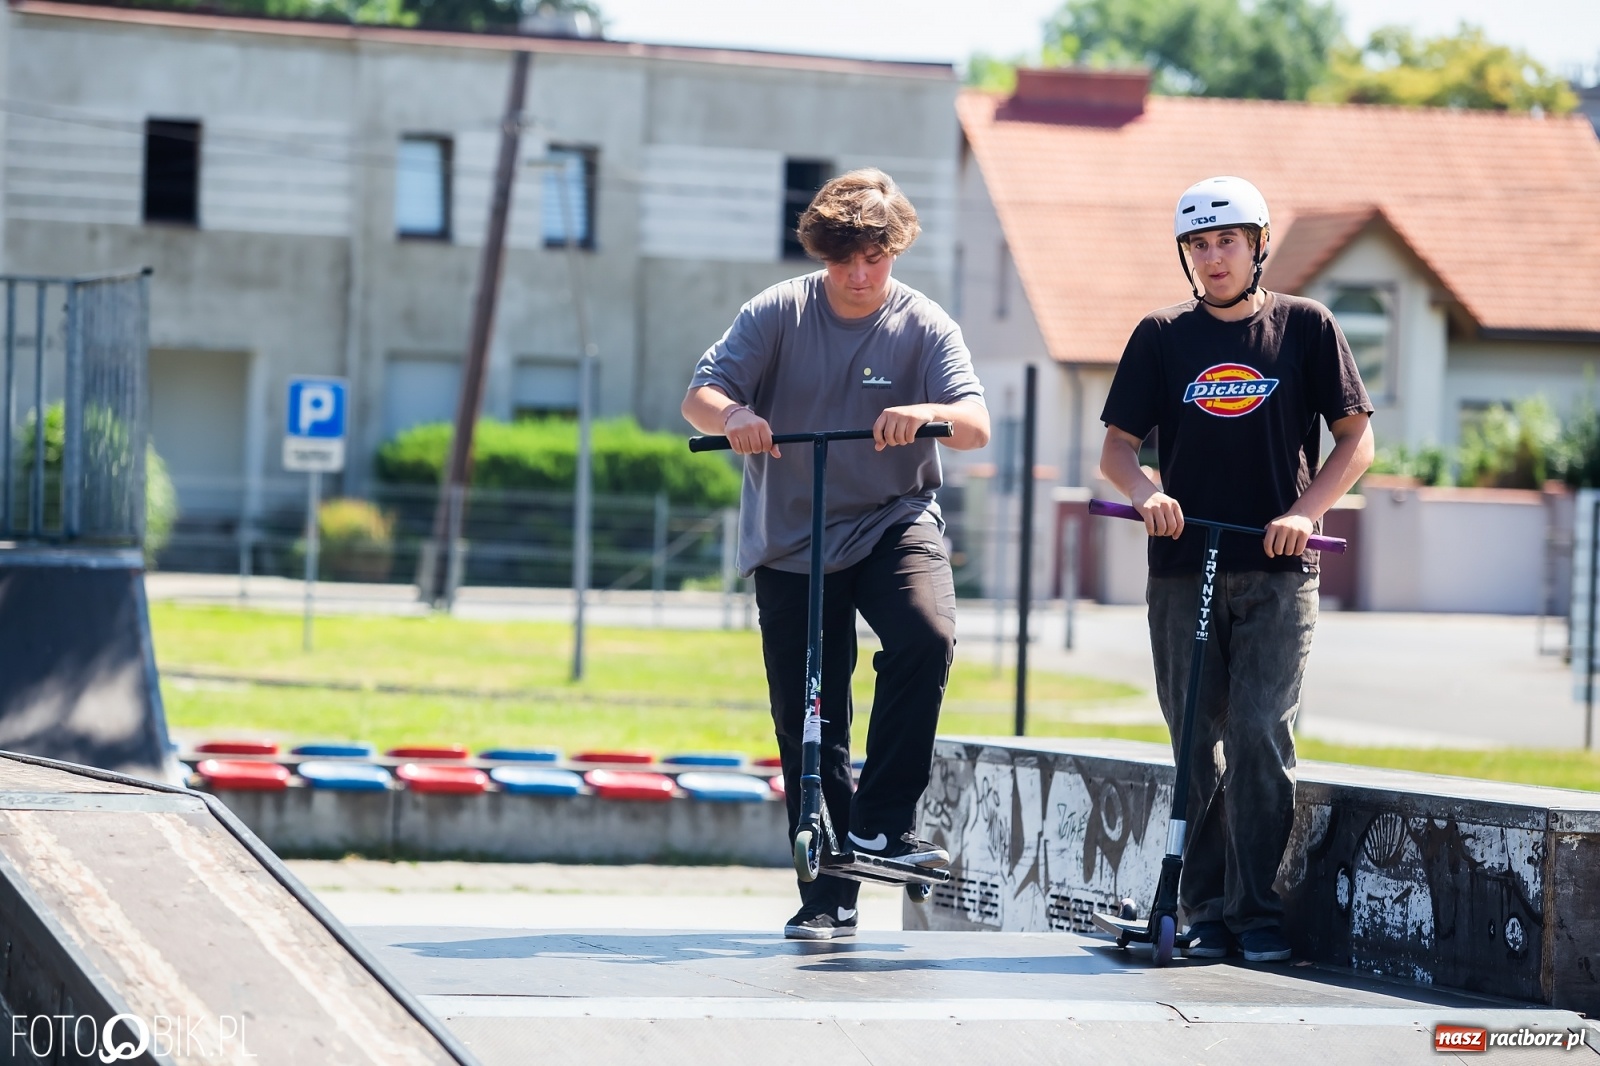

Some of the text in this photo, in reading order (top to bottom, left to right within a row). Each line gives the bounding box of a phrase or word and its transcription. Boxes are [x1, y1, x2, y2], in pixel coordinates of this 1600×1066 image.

[1195, 215, 1217, 225] TSG
[1192, 383, 1268, 398] Dickies
[299, 385, 335, 434] P
[1199, 548, 1218, 631] TRYNYTY
